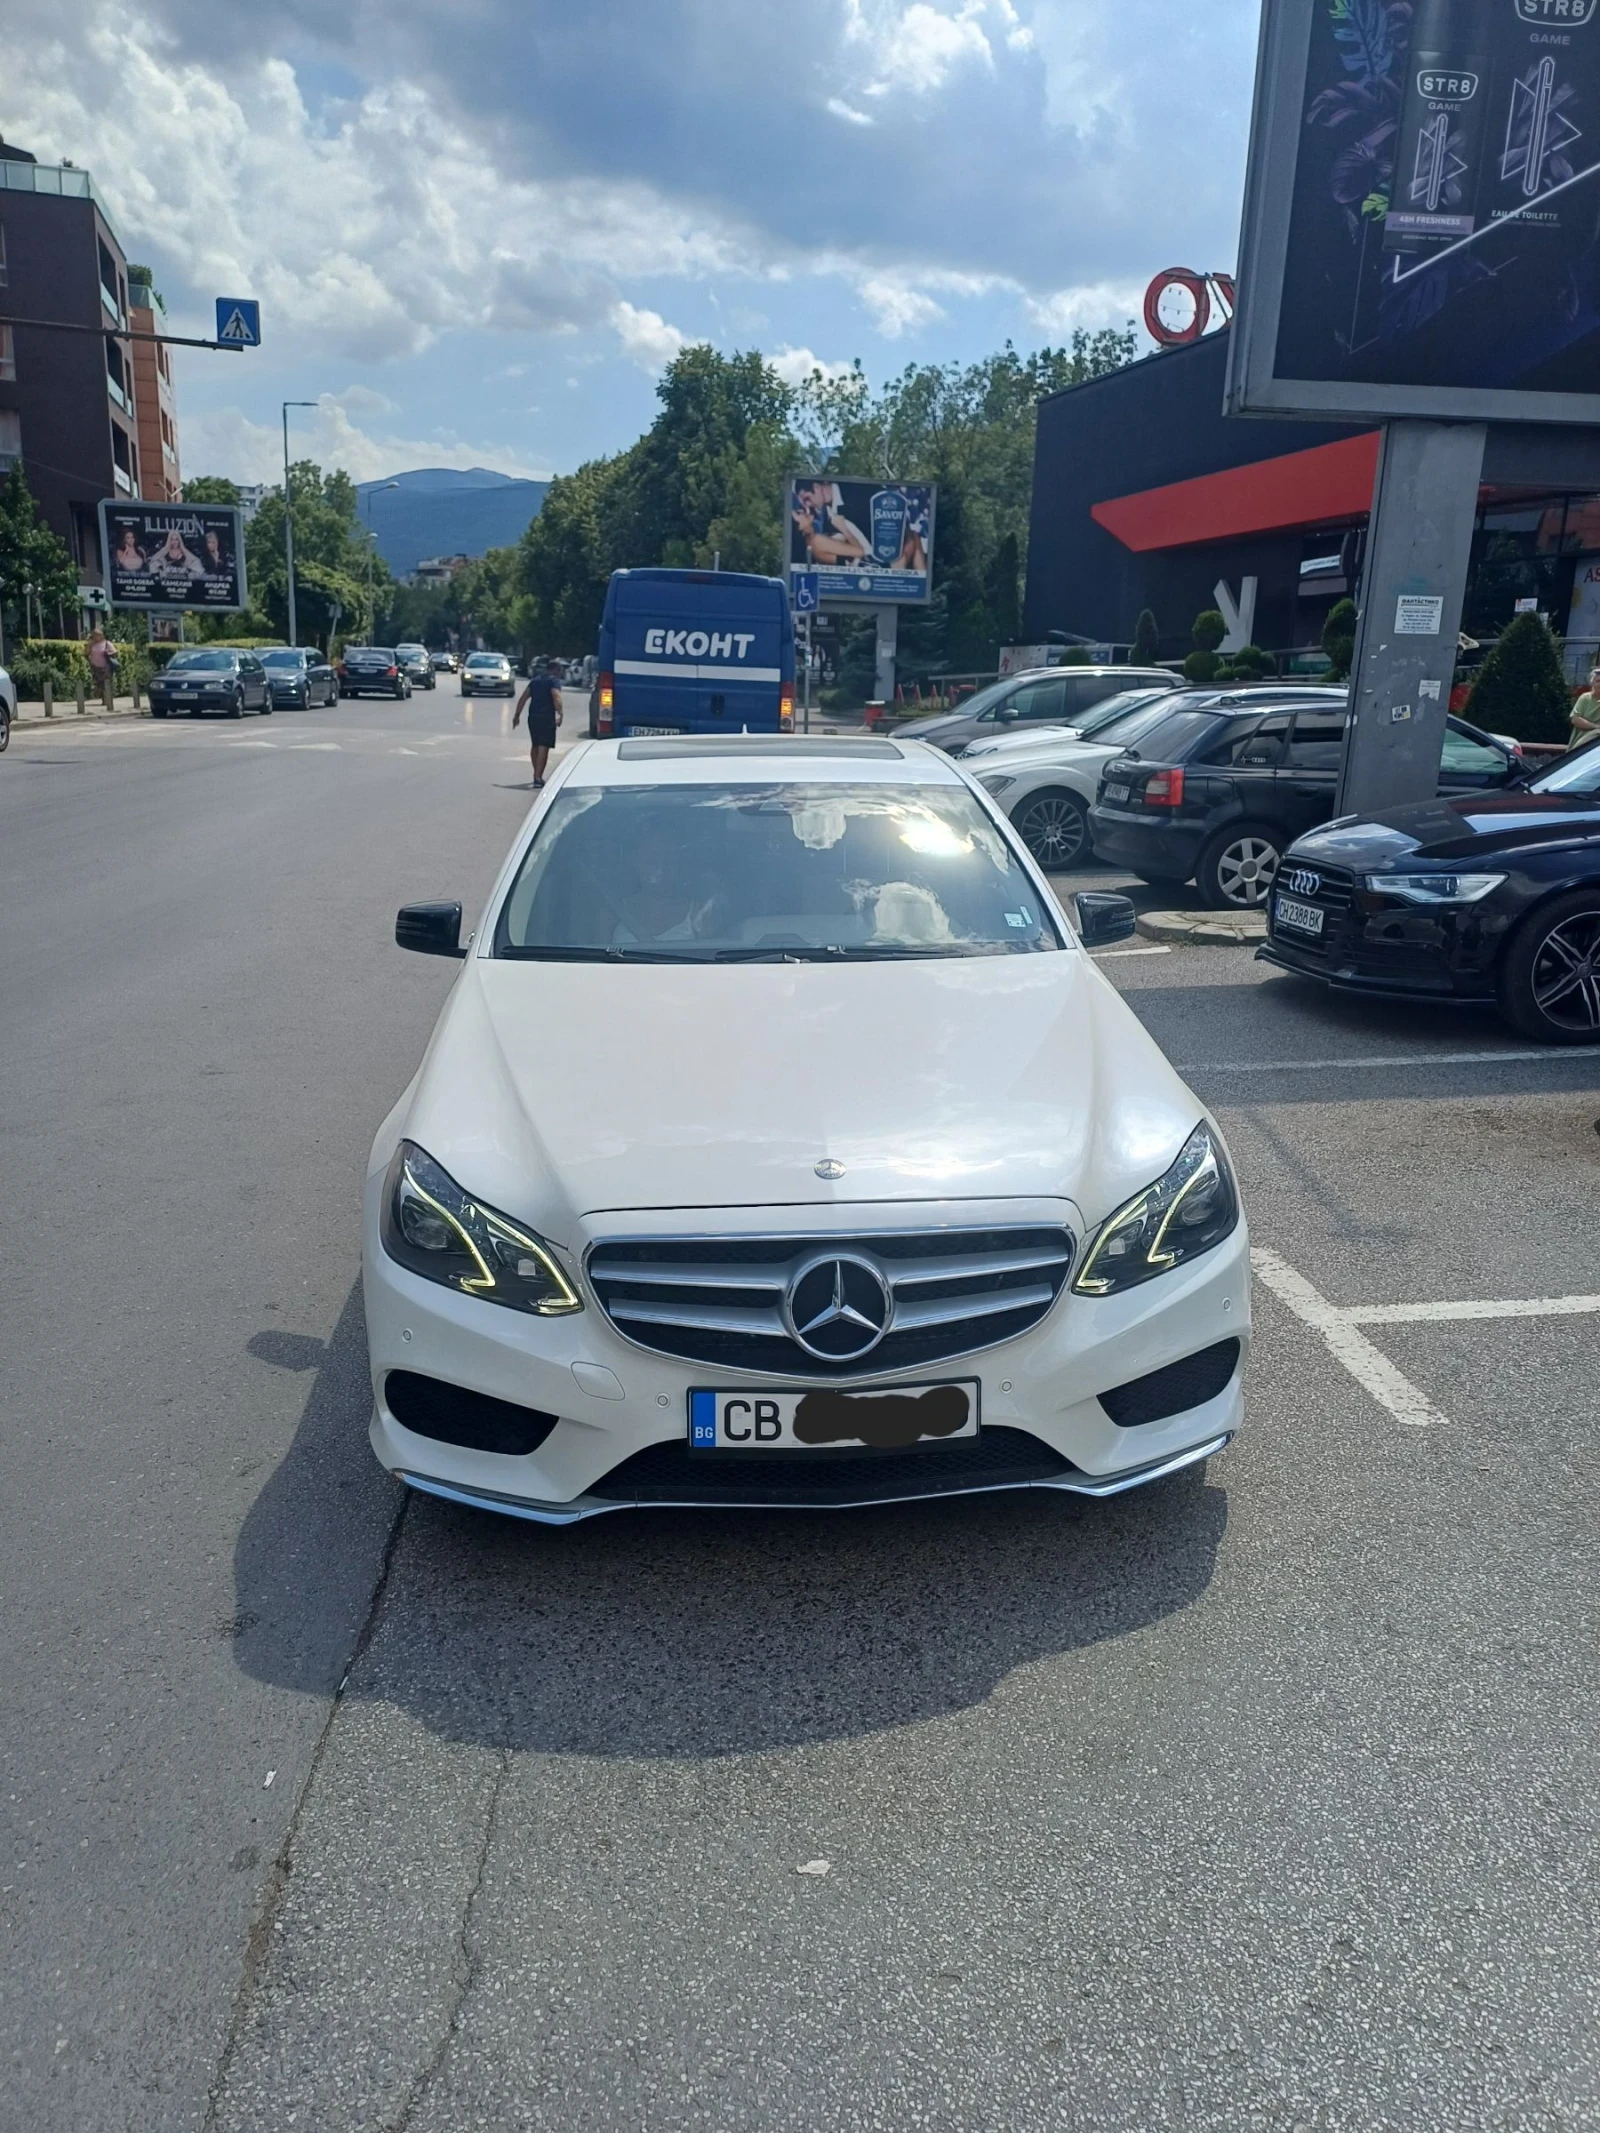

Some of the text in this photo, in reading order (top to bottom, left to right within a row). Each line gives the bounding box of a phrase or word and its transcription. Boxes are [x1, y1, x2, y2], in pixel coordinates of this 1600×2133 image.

[1524, 0, 1585, 17] STR8
[1529, 33, 1571, 46] GAME
[1423, 77, 1471, 94] STR8
[1428, 101, 1463, 112] GAME
[1416, 215, 1461, 226] FRESHNESS
[1522, 211, 1559, 221] TOILETTE
[144, 513, 205, 536] ILLUZION
[645, 629, 755, 659] ЕКОНТ
[724, 1400, 782, 1441] CB
[695, 1427, 713, 1439] BG
